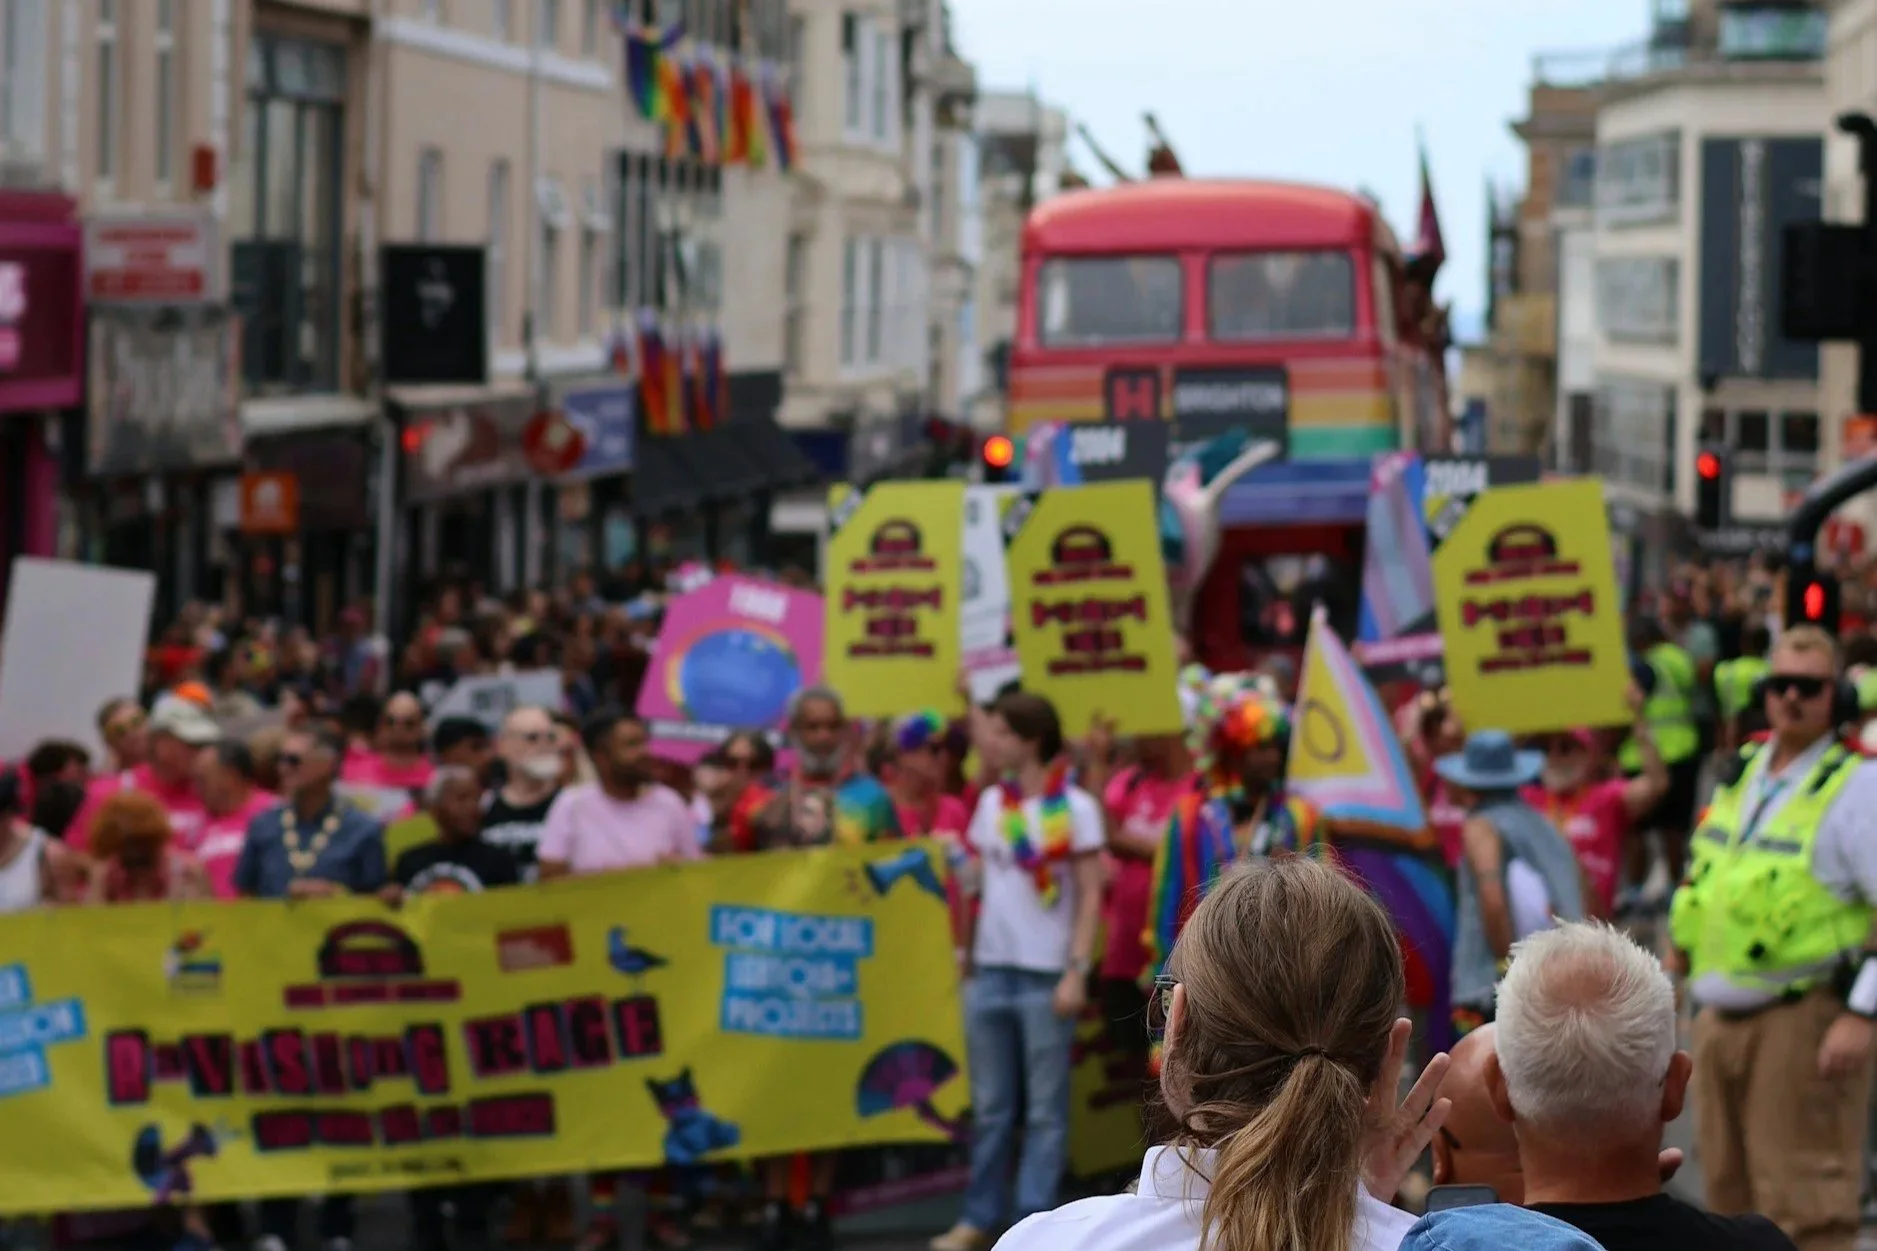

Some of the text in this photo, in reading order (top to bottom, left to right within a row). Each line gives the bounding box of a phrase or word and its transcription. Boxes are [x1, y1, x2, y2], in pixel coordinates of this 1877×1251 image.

[1174, 382, 1284, 414] BRIGHTON
[716, 909, 866, 953] FOR LOCAL
[727, 996, 857, 1035] PROJECTS
